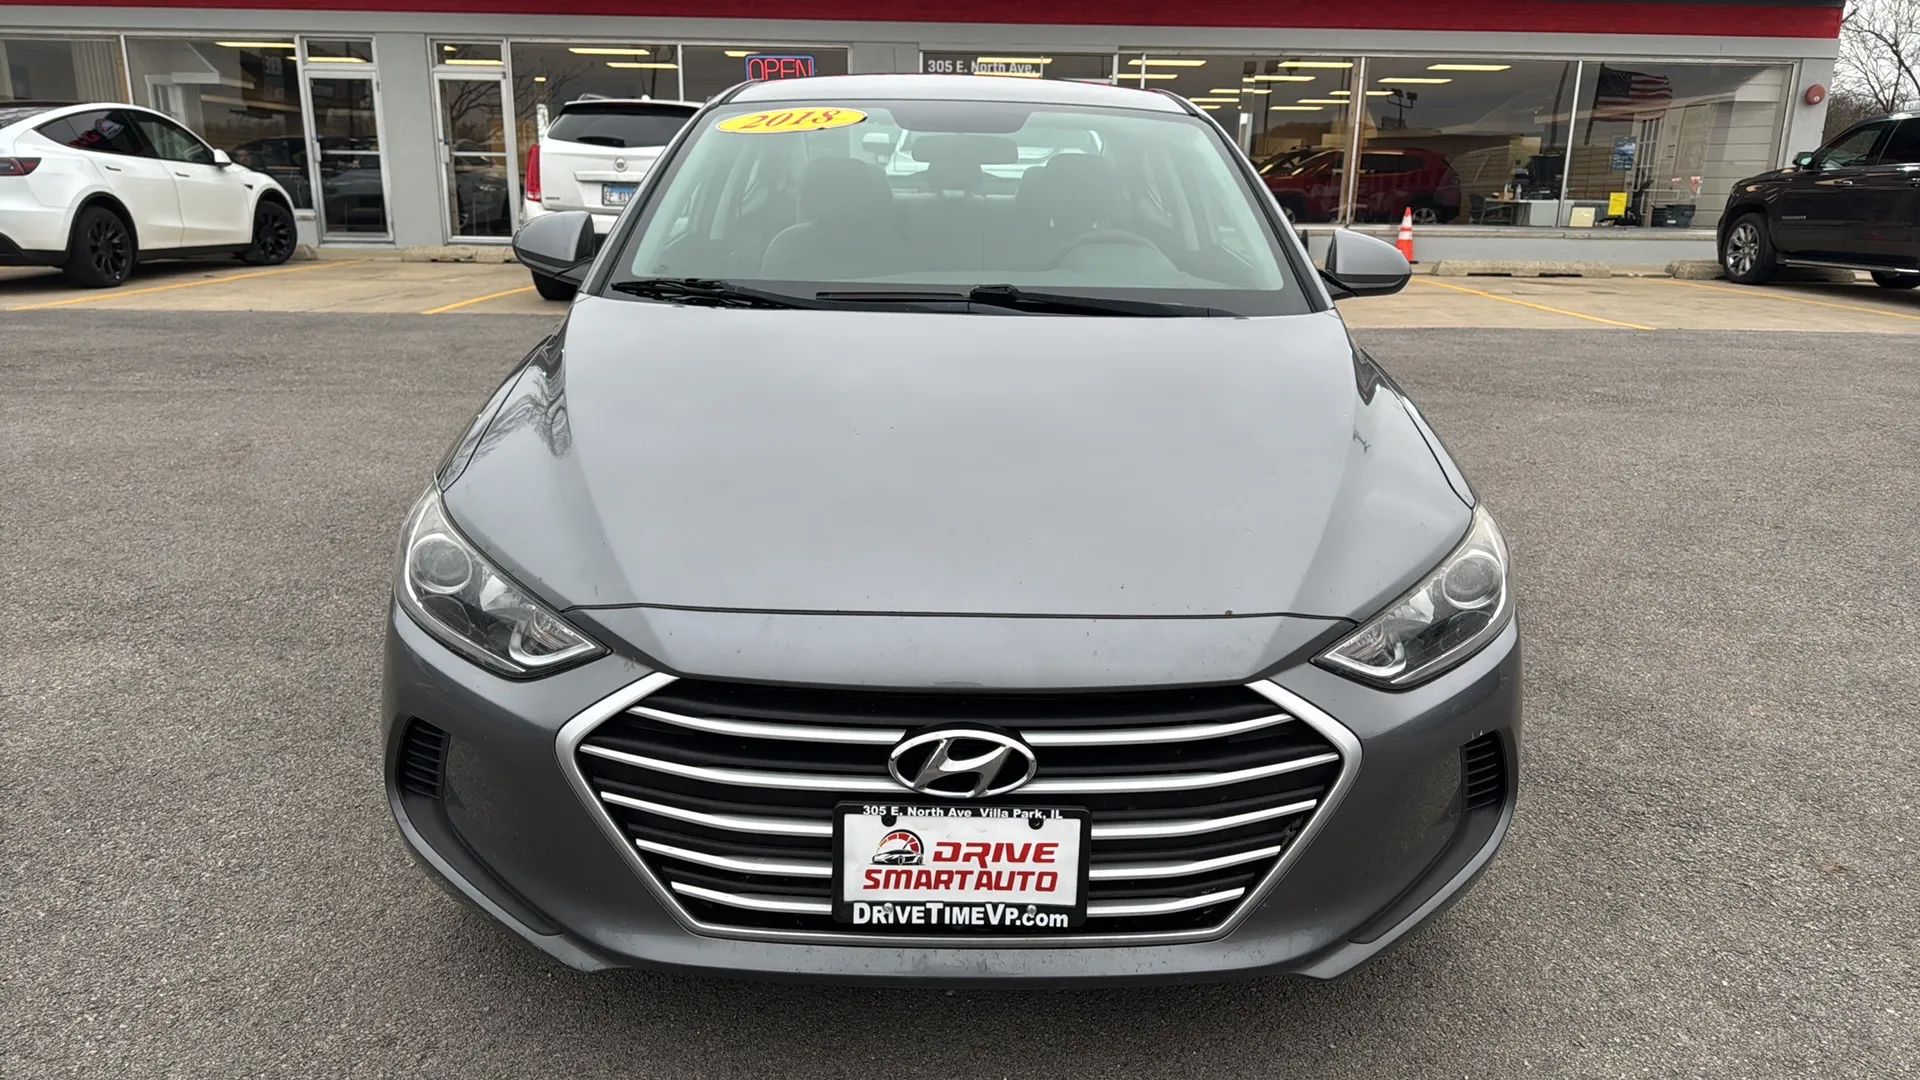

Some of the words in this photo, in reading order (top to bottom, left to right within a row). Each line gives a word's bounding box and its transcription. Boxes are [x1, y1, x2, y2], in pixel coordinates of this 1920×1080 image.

[749, 58, 812, 80] OPEN
[927, 60, 953, 73] 305
[956, 61, 968, 73] E.
[970, 61, 1006, 74] North
[1008, 62, 1037, 75] Ave.
[738, 109, 841, 129] 2018
[863, 805, 887, 816] 305
[890, 806, 903, 816] E.
[907, 806, 944, 817] North
[947, 807, 972, 818] Ave
[980, 808, 1009, 819] Villa
[1013, 808, 1047, 820] Park,
[1051, 809, 1064, 820] IL
[932, 841, 1060, 868] DRIVE
